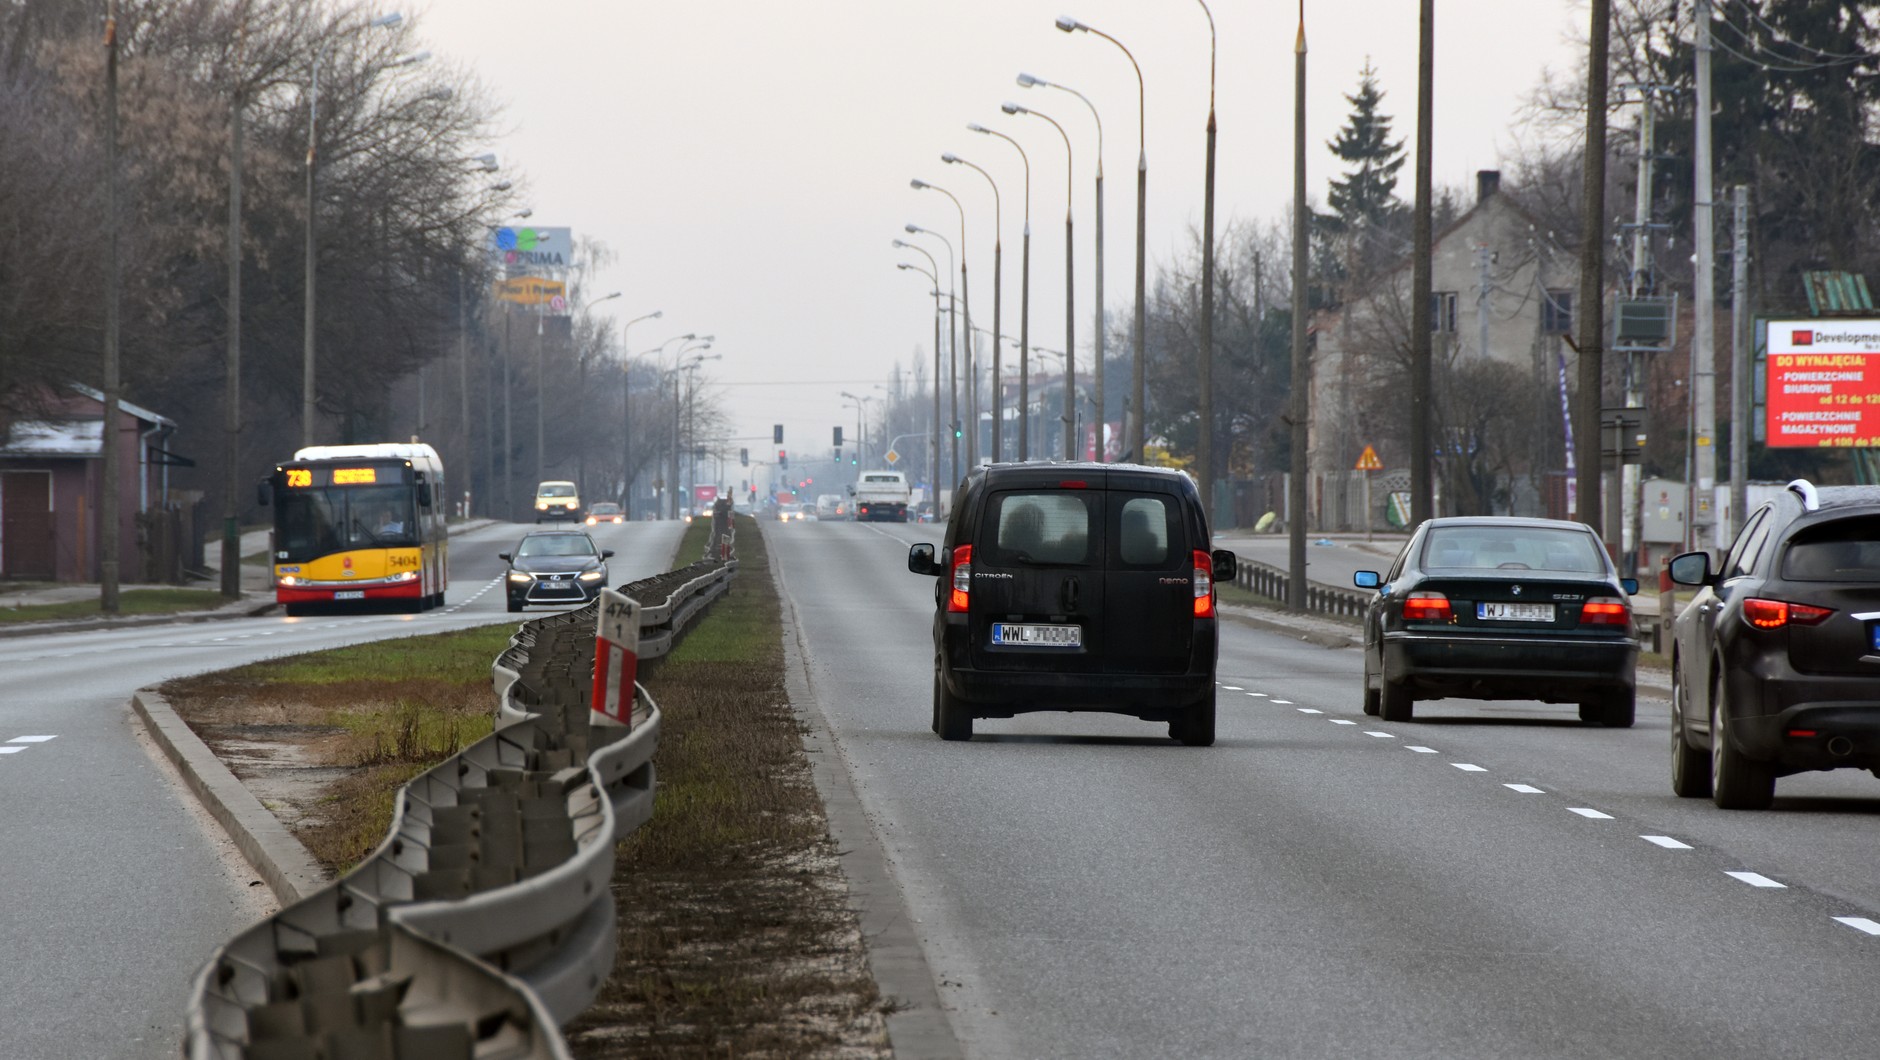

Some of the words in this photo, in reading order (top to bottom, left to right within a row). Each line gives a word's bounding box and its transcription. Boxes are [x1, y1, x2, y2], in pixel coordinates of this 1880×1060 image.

[1776, 356, 1794, 367] DO
[1784, 372, 1863, 381] POWIERZCHNIE
[1783, 384, 1832, 394] BIUROWE
[1782, 412, 1861, 421] POWIERZCHNIE
[1782, 424, 1855, 434] MAGAZYNOWE
[390, 556, 417, 567] 5404
[606, 603, 632, 618] 474
[616, 623, 622, 638] 1
[1002, 626, 1029, 642] WWL
